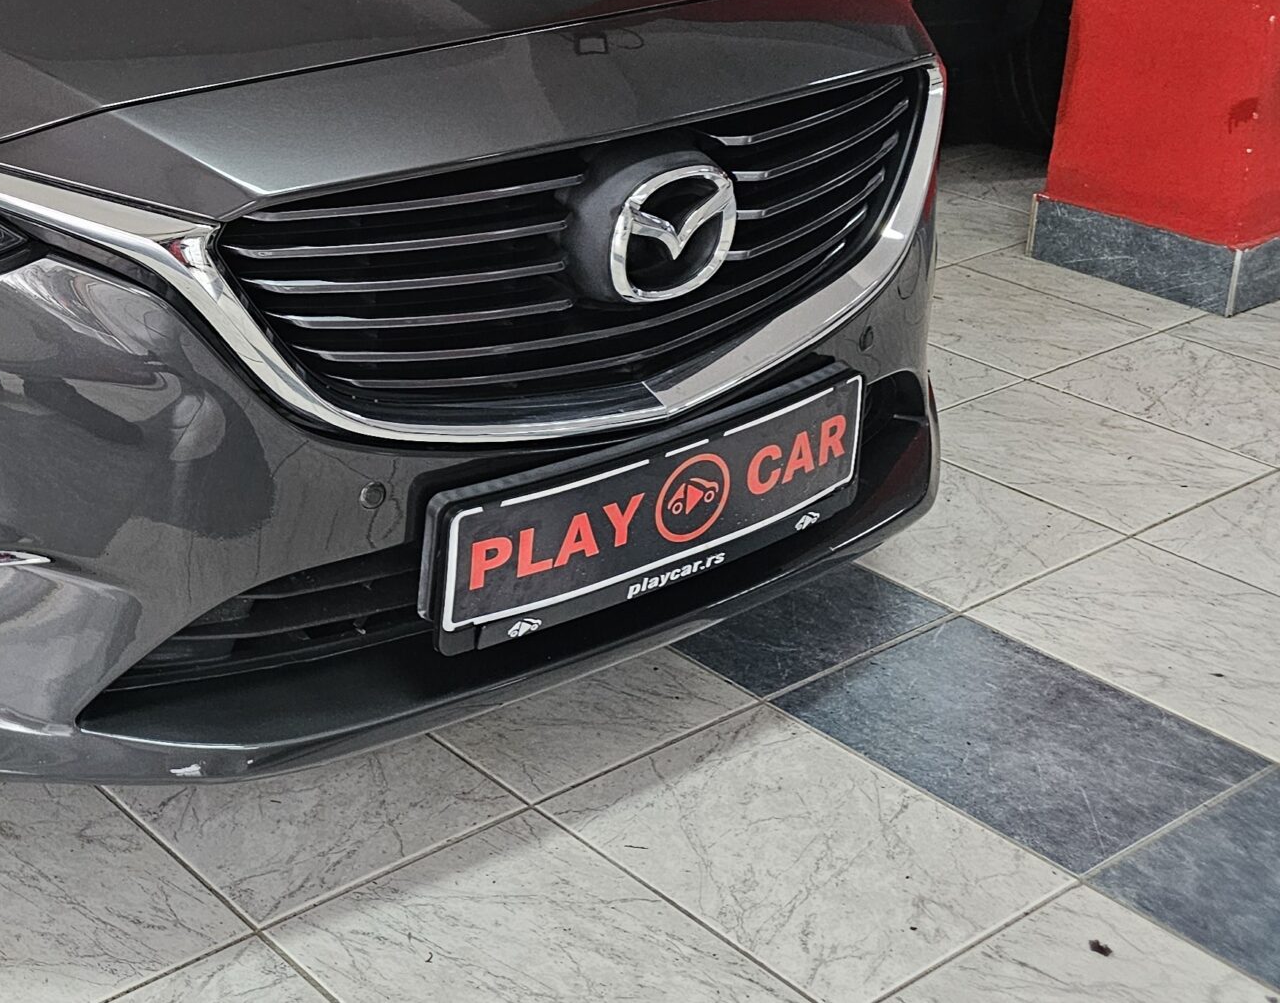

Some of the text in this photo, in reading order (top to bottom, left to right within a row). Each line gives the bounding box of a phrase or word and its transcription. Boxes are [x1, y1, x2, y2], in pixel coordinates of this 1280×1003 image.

[468, 414, 847, 591] PLAY CAR
[626, 552, 726, 600] playcar.rs
